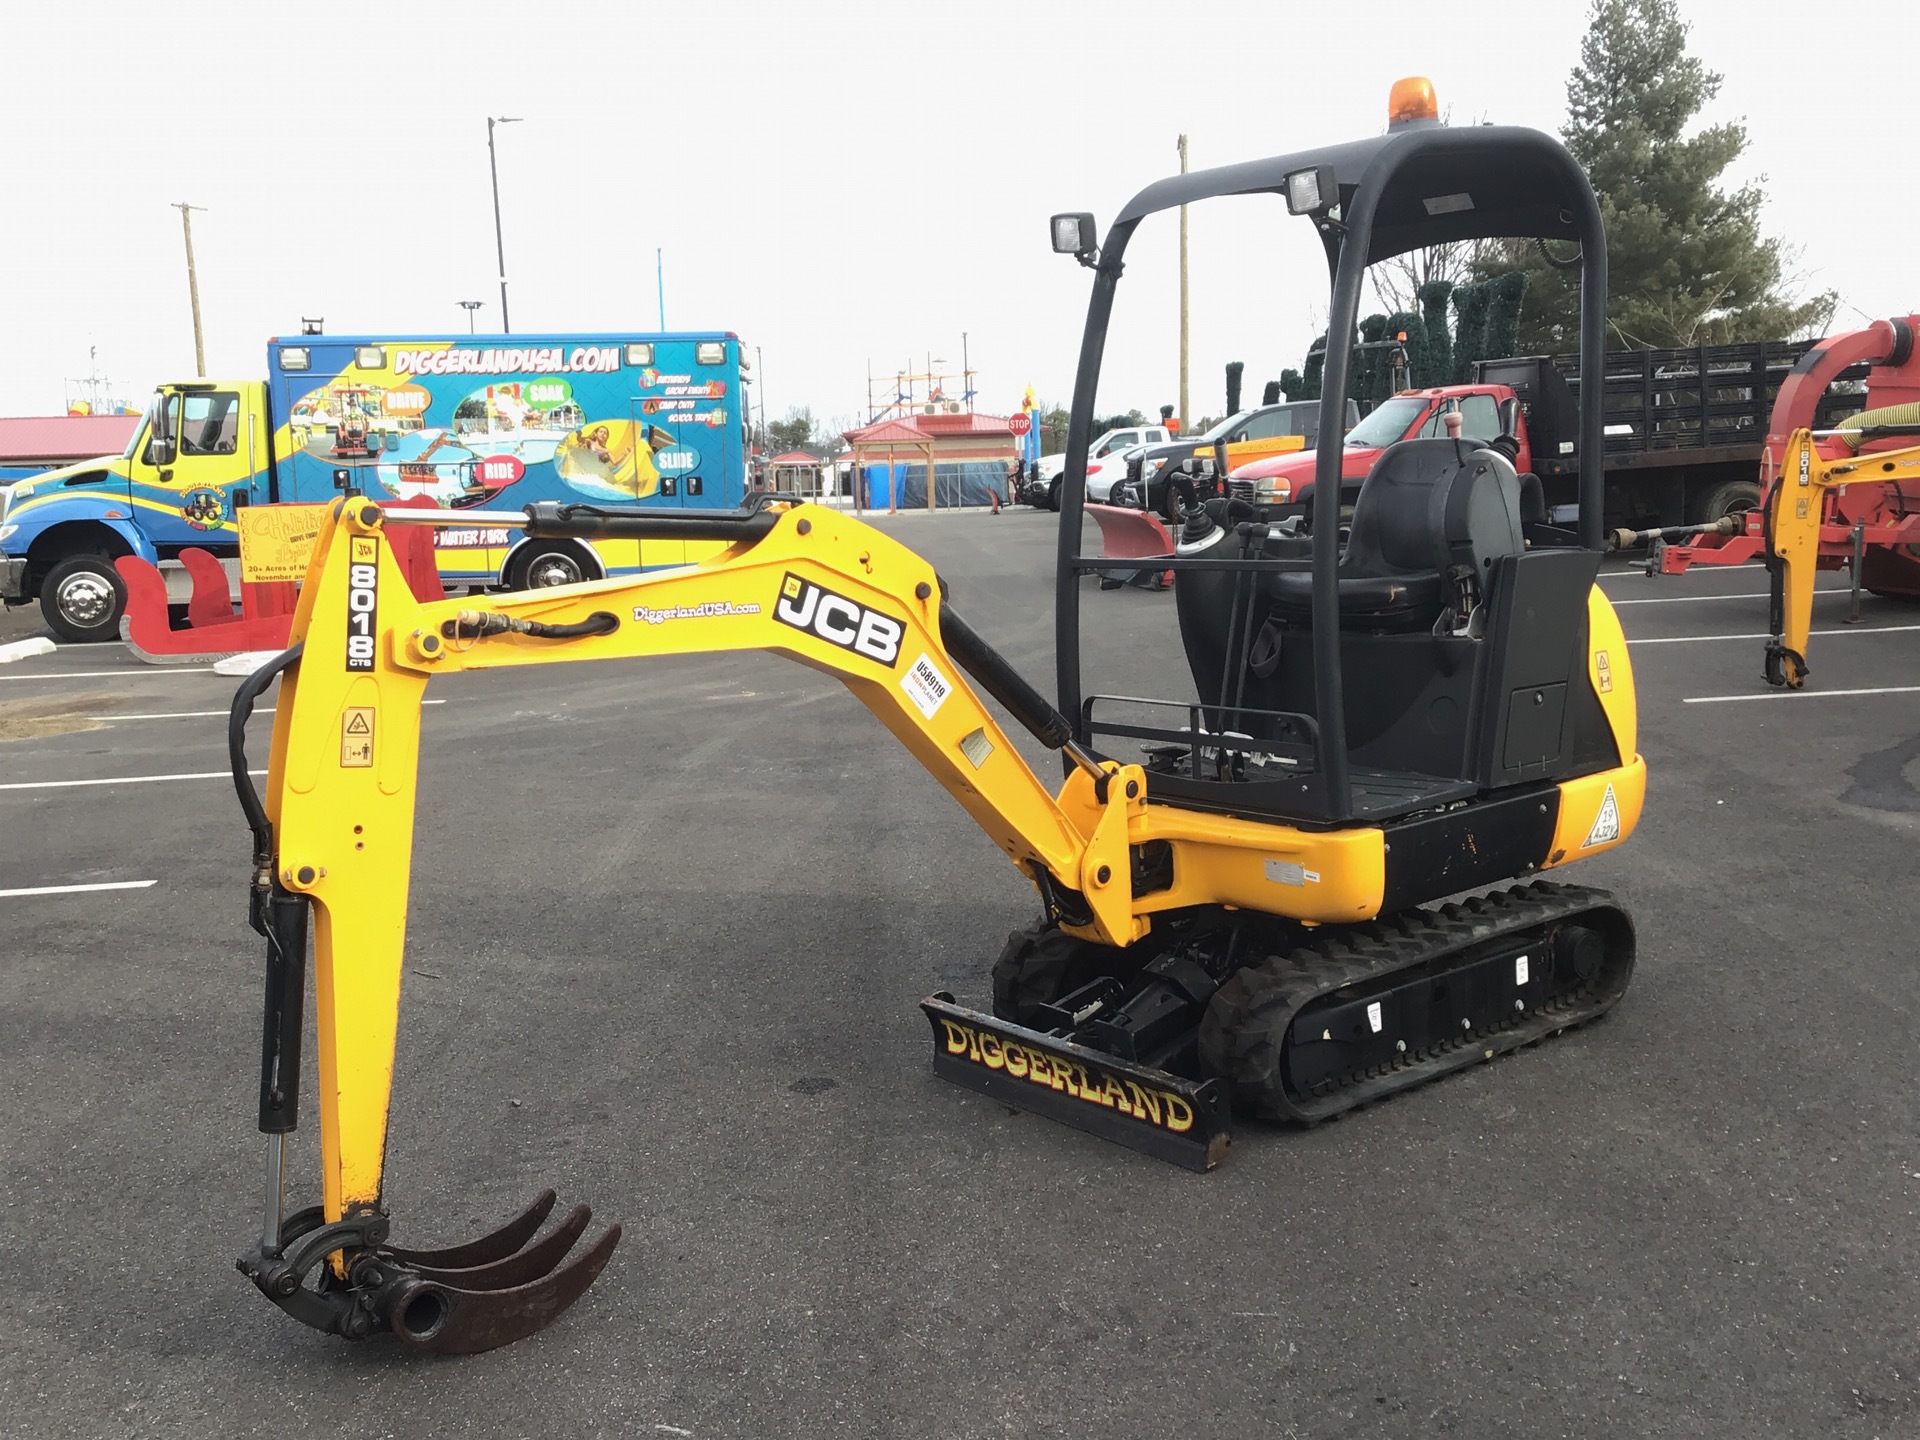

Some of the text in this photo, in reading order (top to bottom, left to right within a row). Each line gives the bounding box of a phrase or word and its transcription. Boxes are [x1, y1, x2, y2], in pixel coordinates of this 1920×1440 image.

[395, 346, 621, 375] DIGGERLANDUSA.COM
[387, 391, 425, 409] DRIVE
[530, 384, 564, 402] SOAK
[1010, 420, 1030, 429] STOP
[485, 462, 515, 479] RIDE
[659, 452, 693, 469] SLIDE
[440, 530, 478, 546] WATER
[479, 529, 511, 545] PARK
[350, 565, 376, 658] 8018
[633, 602, 761, 624] DiggerlandUSA.com
[778, 585, 902, 664] JCB
[916, 661, 946, 698] U589119
[940, 1018, 1194, 1132] DIGGERLAND
